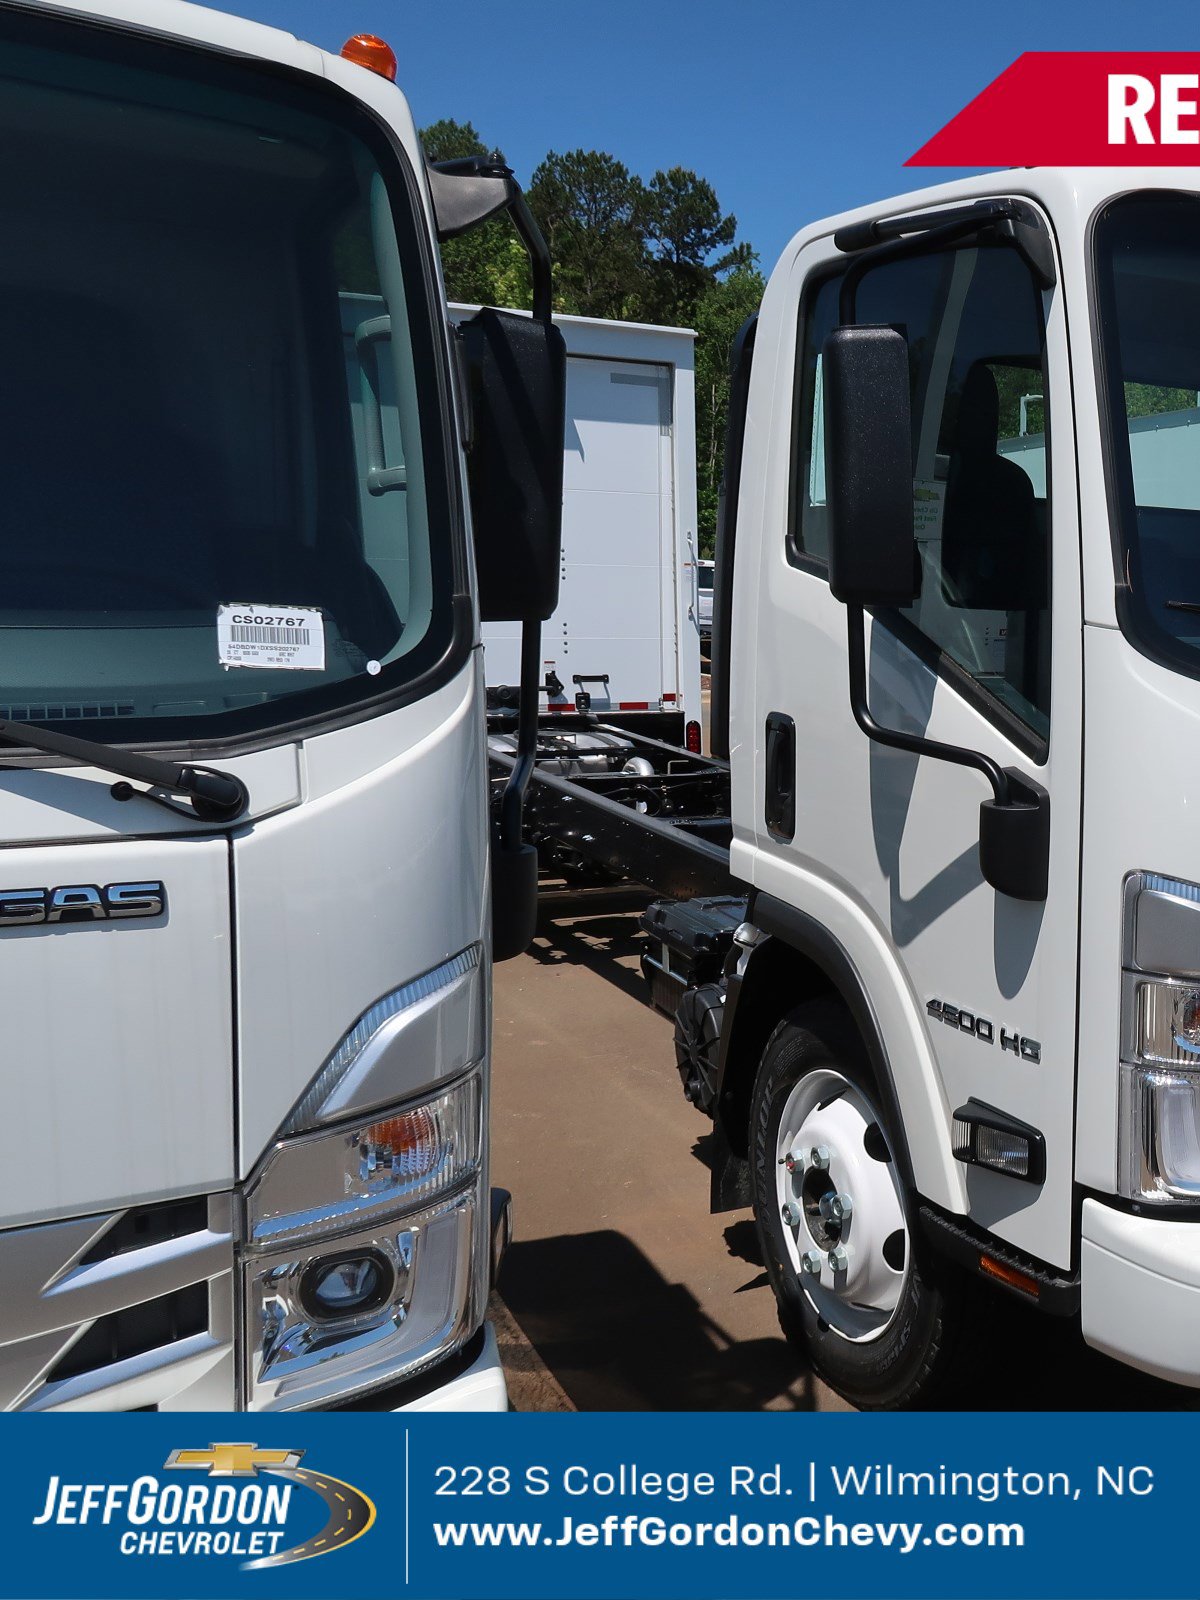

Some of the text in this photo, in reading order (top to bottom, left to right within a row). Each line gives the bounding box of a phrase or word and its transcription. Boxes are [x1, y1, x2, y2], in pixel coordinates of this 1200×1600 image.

[232, 615, 305, 627] CS02767
[926, 998, 1042, 1065] 4500 HG
